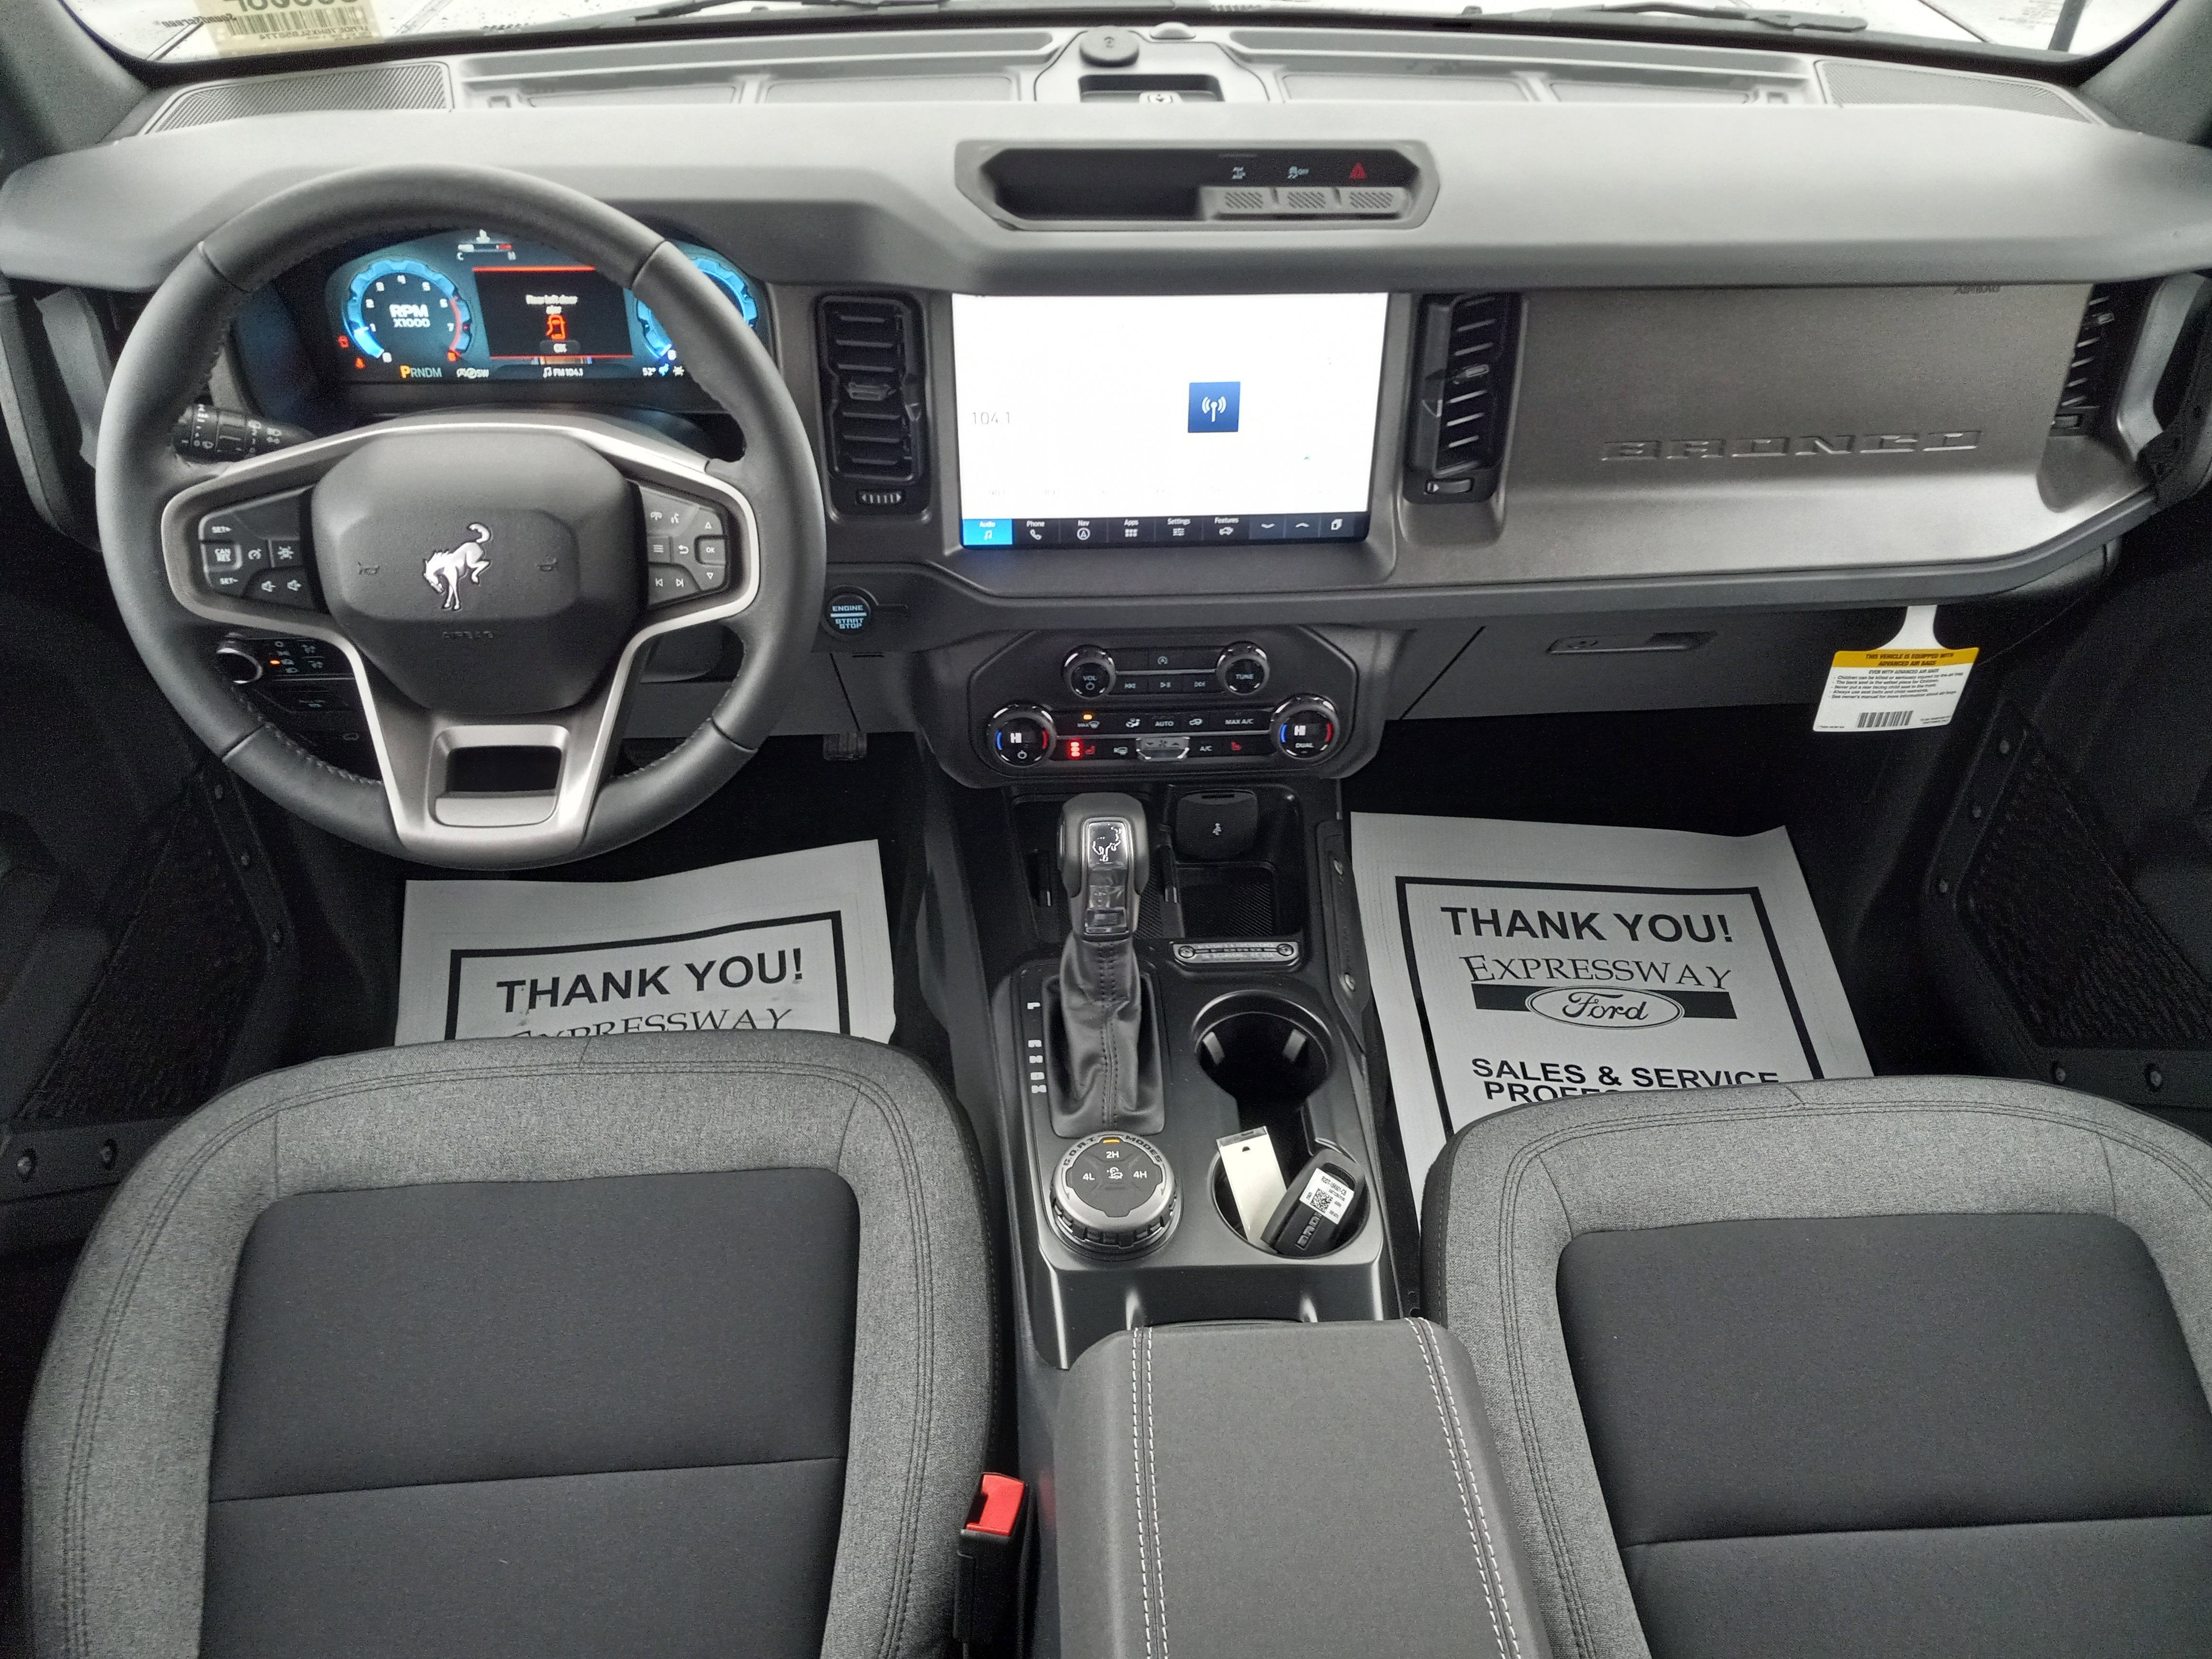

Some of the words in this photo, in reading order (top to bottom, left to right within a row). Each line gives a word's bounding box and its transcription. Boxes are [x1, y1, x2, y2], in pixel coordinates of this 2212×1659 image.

[397, 275, 406, 284] 4
[365, 299, 375, 308] 2
[389, 304, 429, 318] RPM
[393, 318, 431, 327] X1000
[447, 323, 455, 332] 7
[971, 411, 1011, 425] 104.1
[1601, 430, 1983, 461] BRONCO
[1214, 516, 1239, 524] Features
[1440, 905, 1608, 942] THANK
[1612, 913, 1733, 943] YOU!
[495, 965, 671, 1013] THANK
[684, 948, 804, 992] YOU!
[1458, 955, 1732, 990] EXPRESSWAY
[1561, 991, 1649, 1022] Ford
[510, 1008, 793, 1038] RESSWAY
[1471, 1058, 1586, 1085] SALES
[1598, 1066, 1623, 1087] &
[1630, 1067, 1780, 1089] SERVICE
[1125, 1134, 1163, 1163] MODES
[1133, 1171, 1147, 1179] 4H
